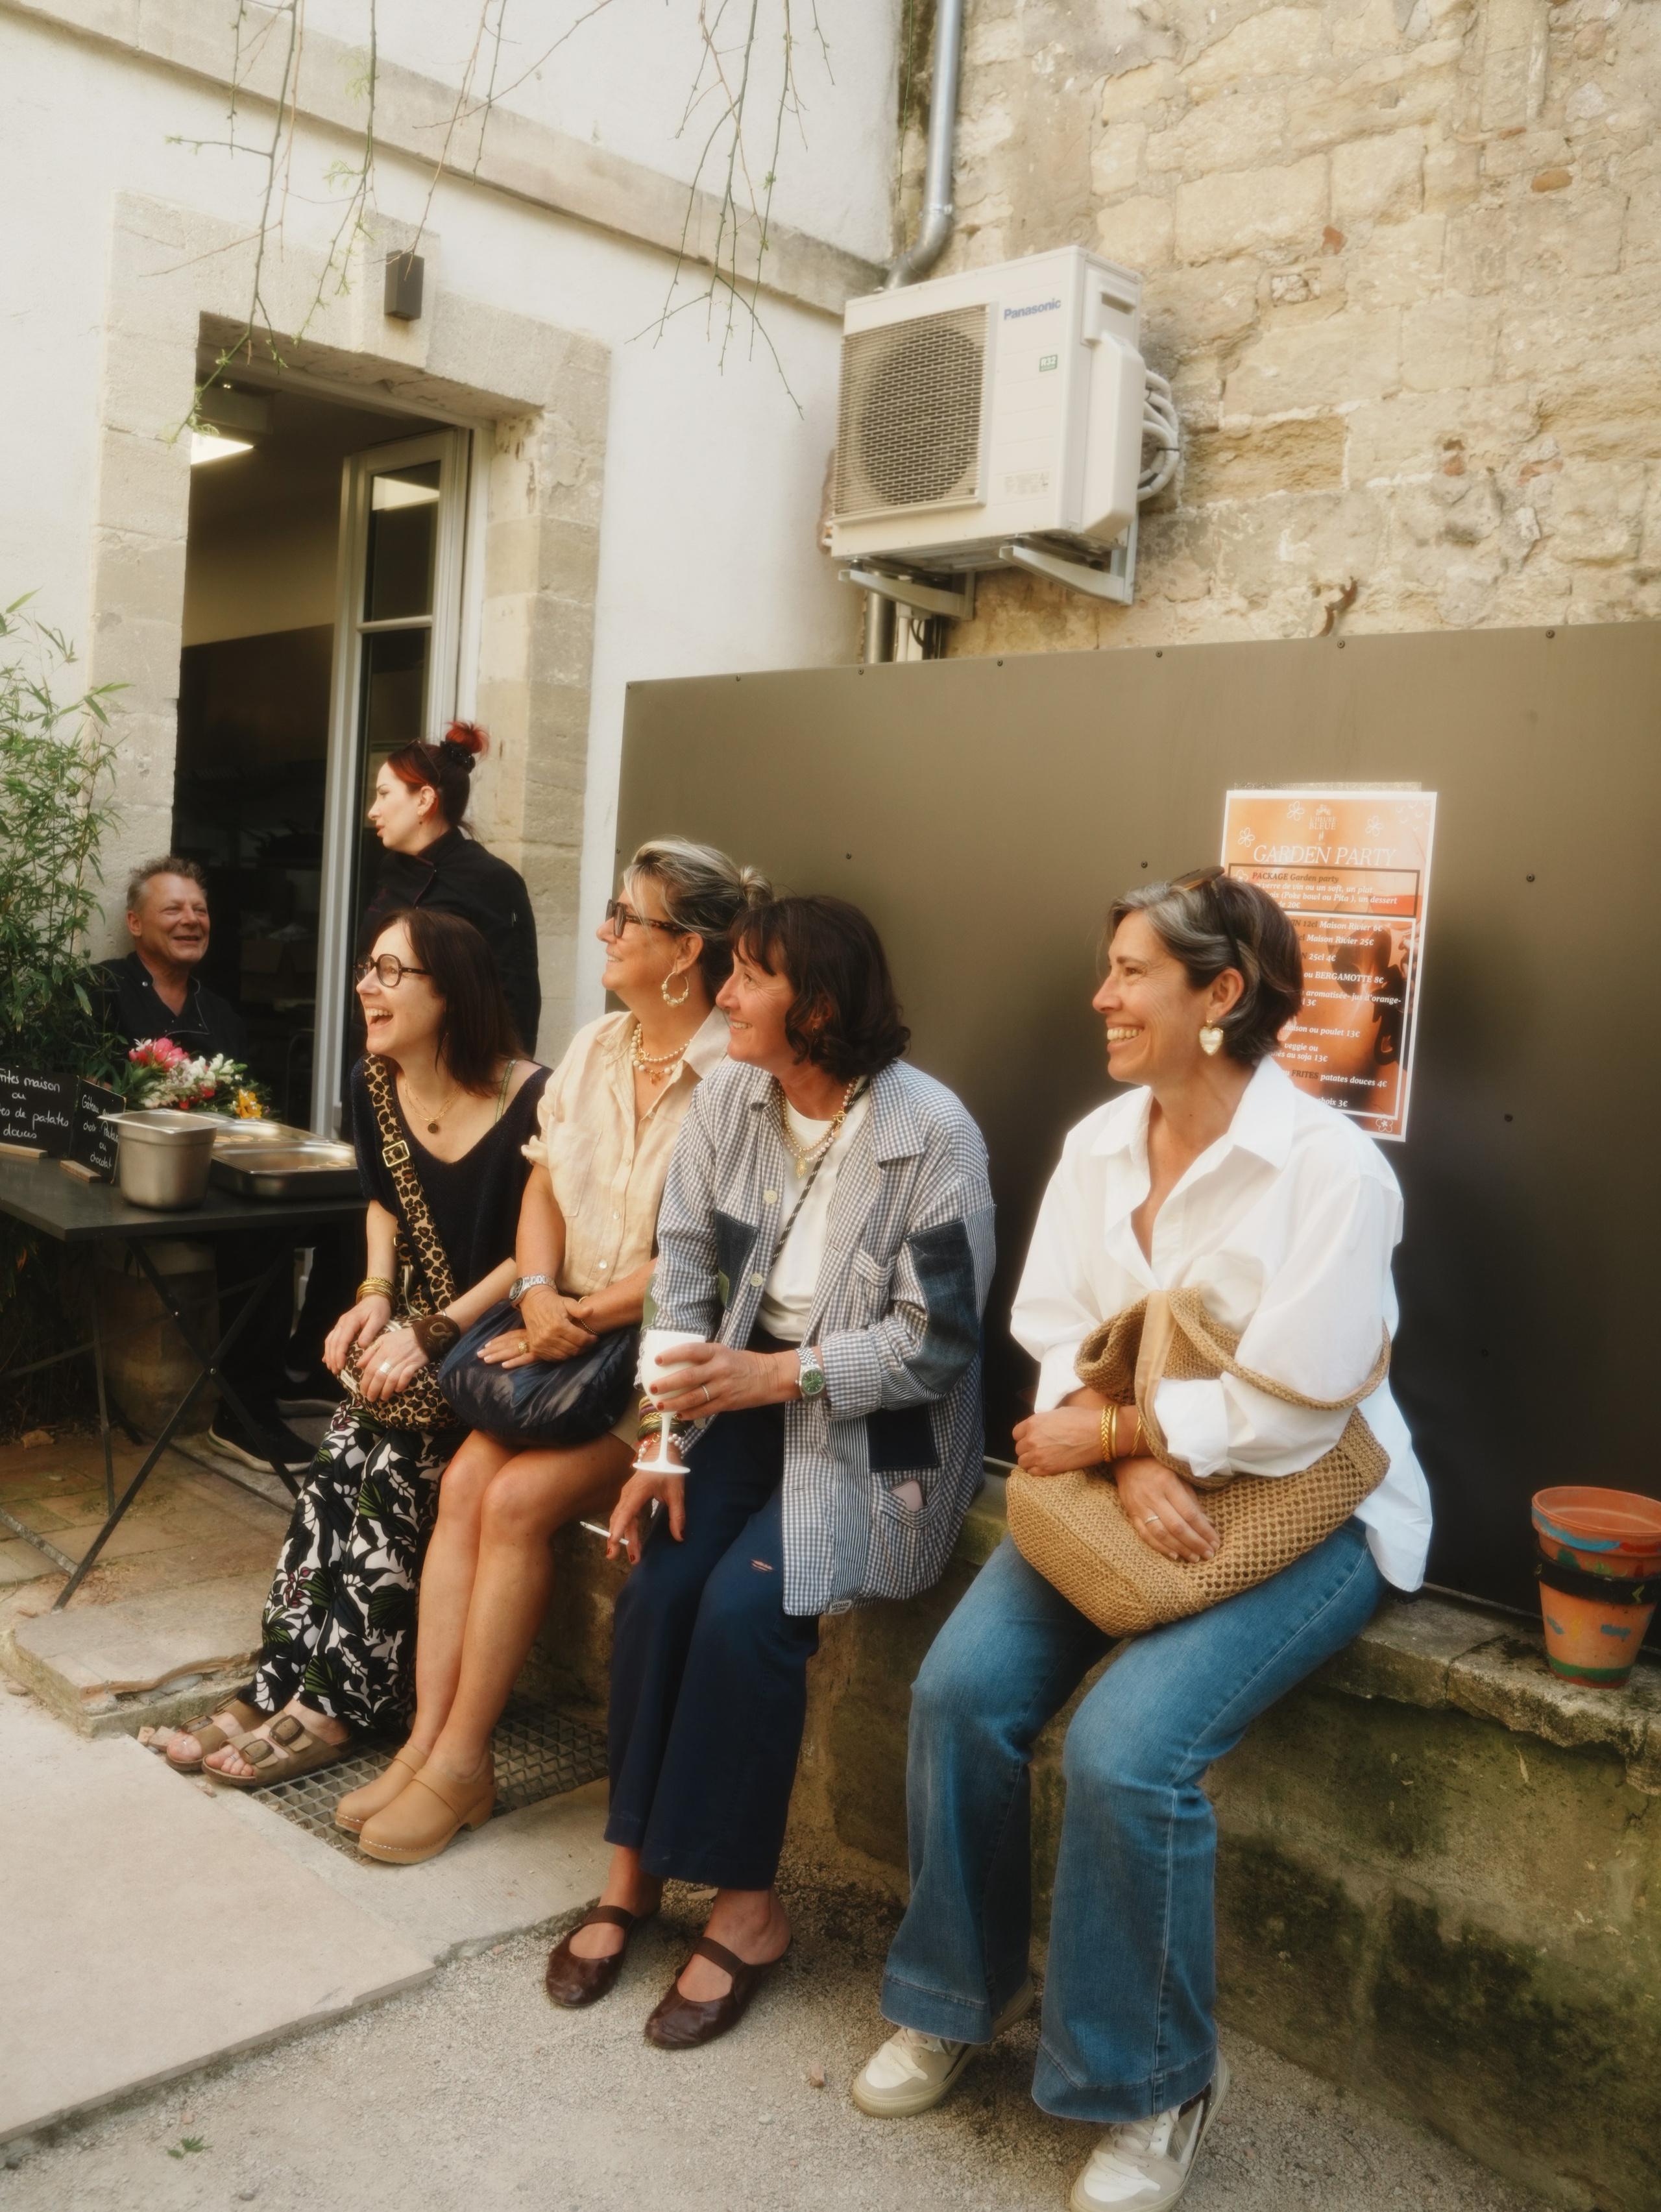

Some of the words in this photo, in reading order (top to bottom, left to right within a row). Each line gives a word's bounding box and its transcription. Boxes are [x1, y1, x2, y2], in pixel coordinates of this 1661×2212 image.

[1004, 298, 1061, 320] Panasonic
[1041, 356, 1056, 367] R32
[1254, 845, 1331, 864] GARDEN
[1335, 847, 1397, 866] PARTY
[1348, 922, 1372, 930] Rivier
[1307, 933, 1333, 943] Maison
[1335, 936, 1358, 944] Rivier
[1315, 971, 1372, 983] BERGAMOTTE
[1320, 1028, 1344, 1037] poulet
[1285, 1043, 1307, 1052] veggie
[0, 1068, 19, 1084] rites
[24, 1077, 60, 1093] maison
[1291, 1070, 1319, 1079] FRITES
[1320, 1074, 1348, 1083] patates
[1350, 1076, 1376, 1086] douces
[15, 1107, 27, 1118] de
[32, 1110, 69, 1131] patates
[99, 1142, 106, 1151] ou
[90, 1151, 112, 1170] chocolat
